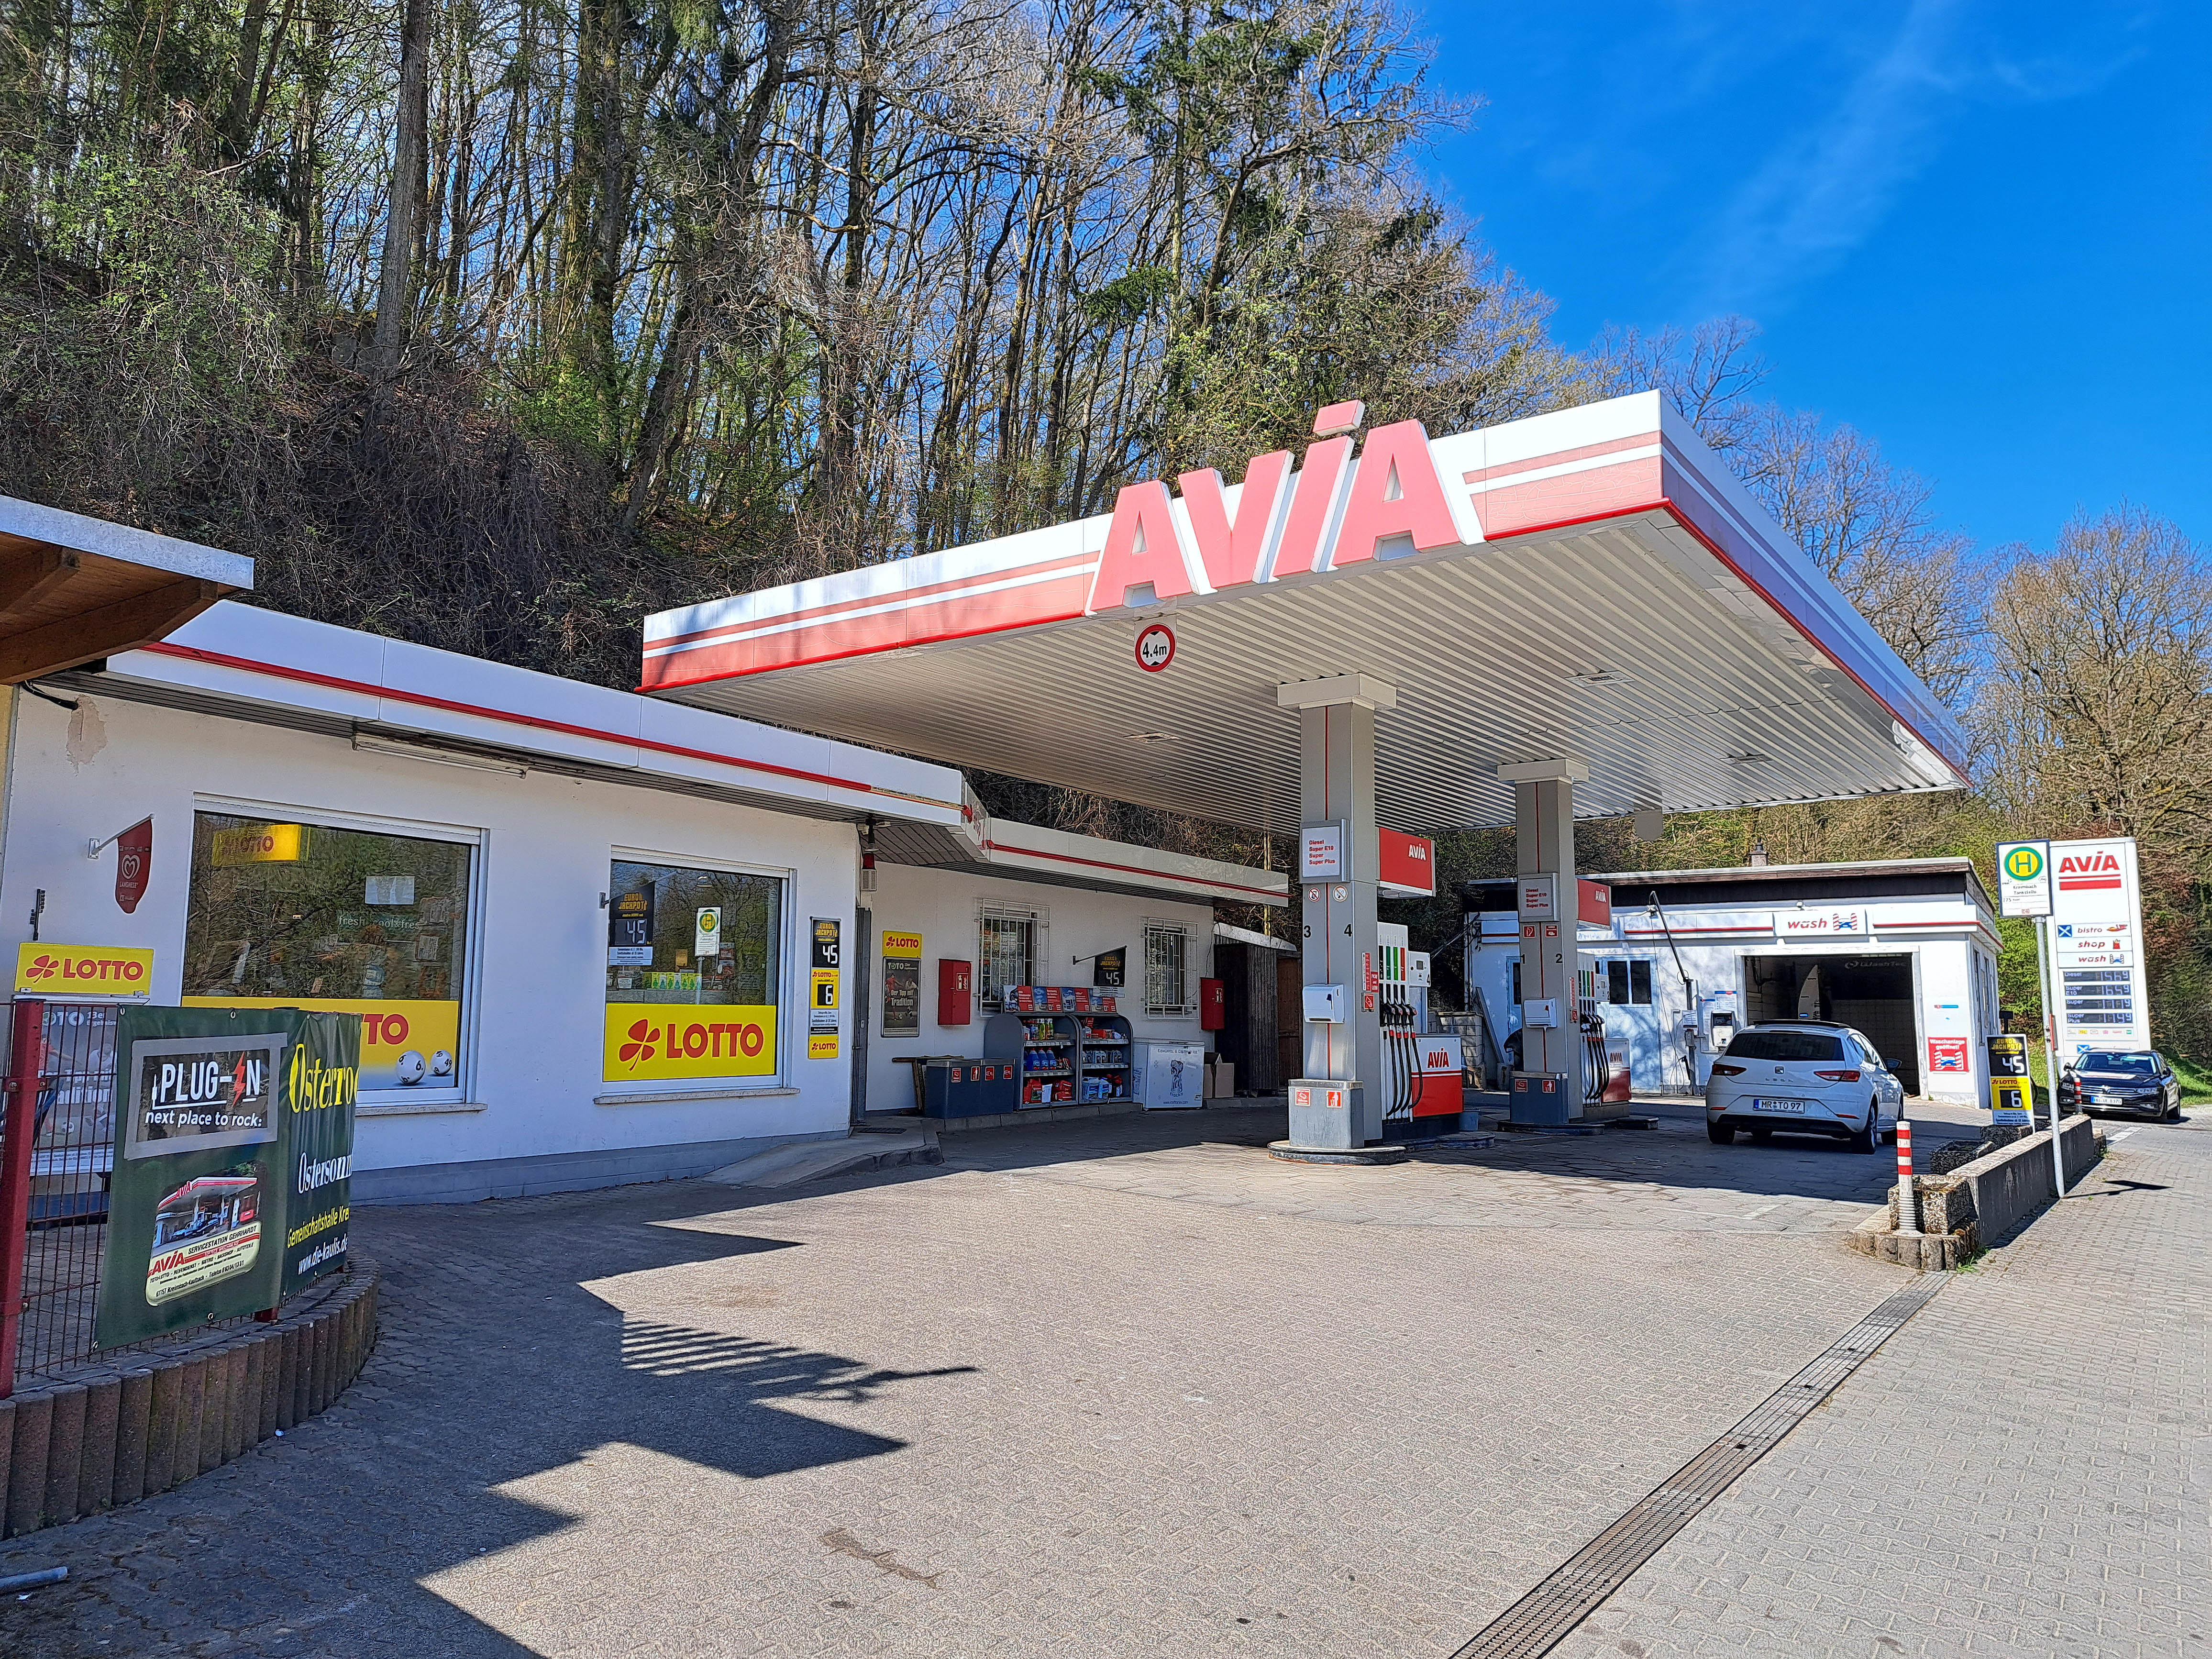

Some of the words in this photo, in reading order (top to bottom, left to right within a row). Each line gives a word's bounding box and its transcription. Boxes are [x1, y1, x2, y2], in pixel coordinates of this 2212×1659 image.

[2015, 854, 2032, 873] H
[1304, 926, 1311, 938] 3
[1344, 924, 1352, 937] 4
[1788, 918, 1827, 929] wash
[627, 920, 646, 944] 45
[896, 938, 919, 948] LOTTO
[2078, 940, 2105, 949] shop
[823, 945, 838, 964] 45
[1521, 954, 1525, 964] 1
[1556, 953, 1562, 963] 2
[63, 958, 144, 981] LOTTO
[887, 962, 904, 970] TOTO
[1106, 972, 1119, 985] 45
[1427, 973, 1430, 985] 4
[826, 985, 833, 1005] 6
[891, 998, 913, 1006] Tradition
[42, 1011, 85, 1026] OTO
[666, 1023, 764, 1059] LOTTO
[2002, 1056, 2024, 1073] 45
[2011, 1091, 2022, 1107] 6
[145, 1110, 175, 1124] next
[177, 1110, 212, 1128] place
[215, 1112, 228, 1125] to
[232, 1113, 262, 1127] rock:
